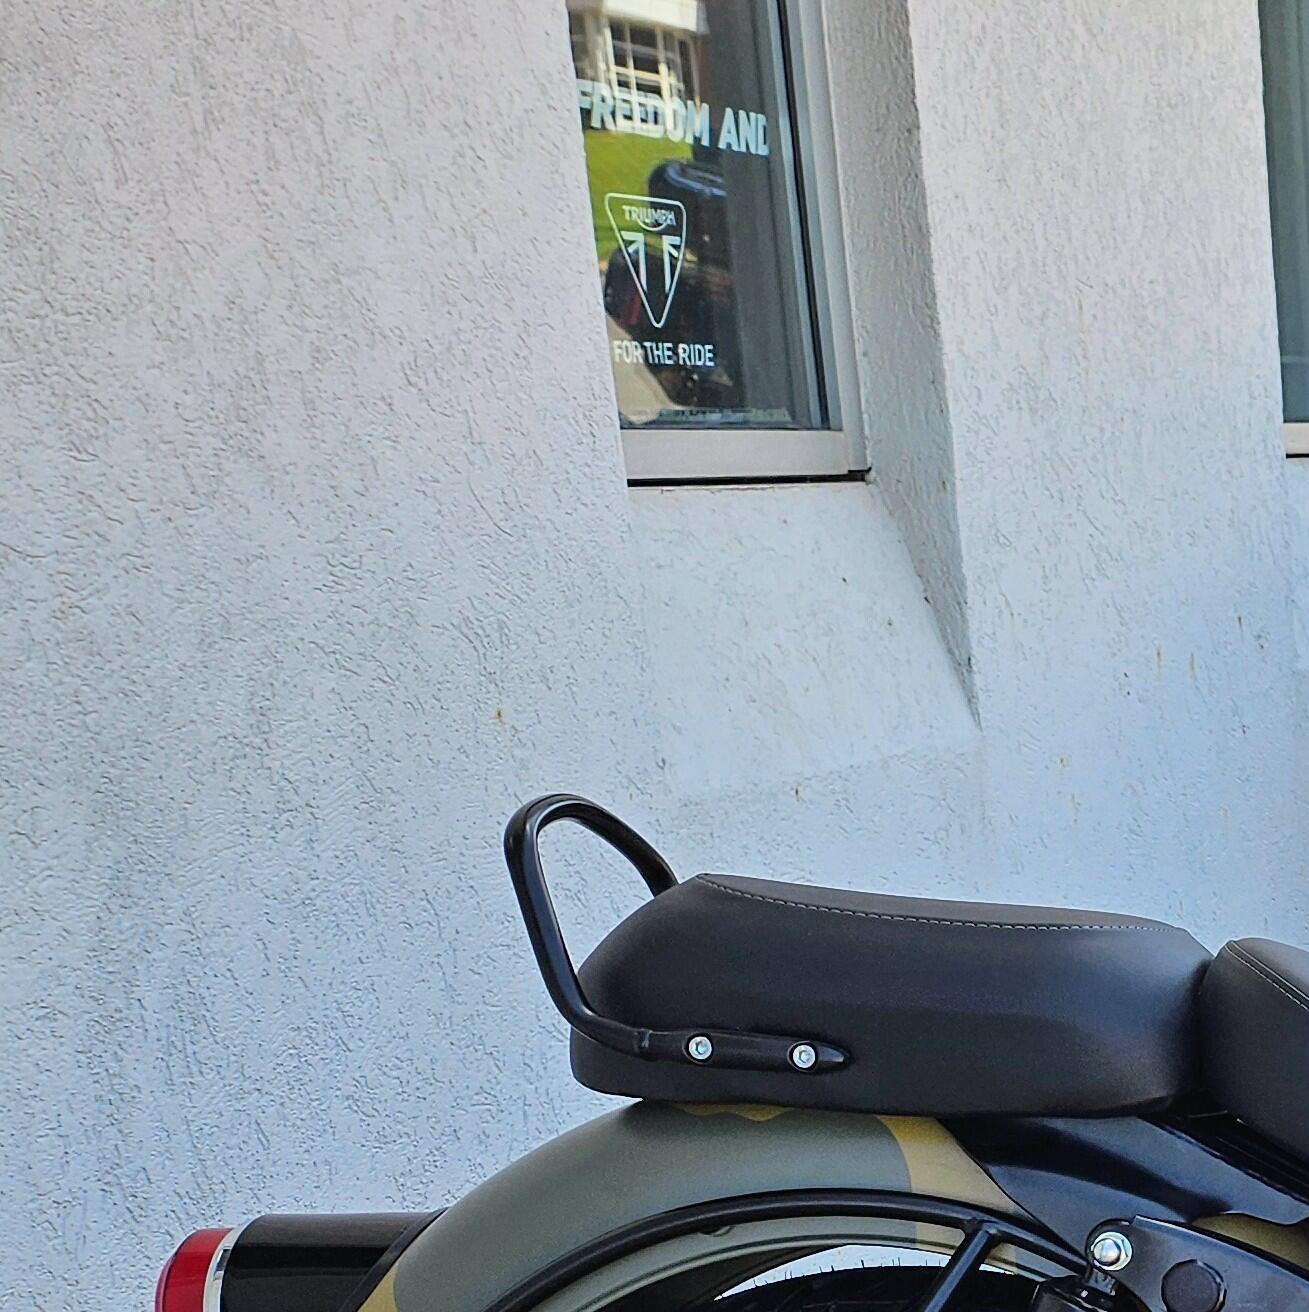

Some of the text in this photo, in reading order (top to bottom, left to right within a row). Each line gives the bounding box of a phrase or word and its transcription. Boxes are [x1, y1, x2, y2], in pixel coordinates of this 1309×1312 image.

[576, 78, 770, 156] FREEDOM AND
[622, 205, 677, 231] TRIUMPH
[613, 340, 715, 368] FOR THE RIDE
